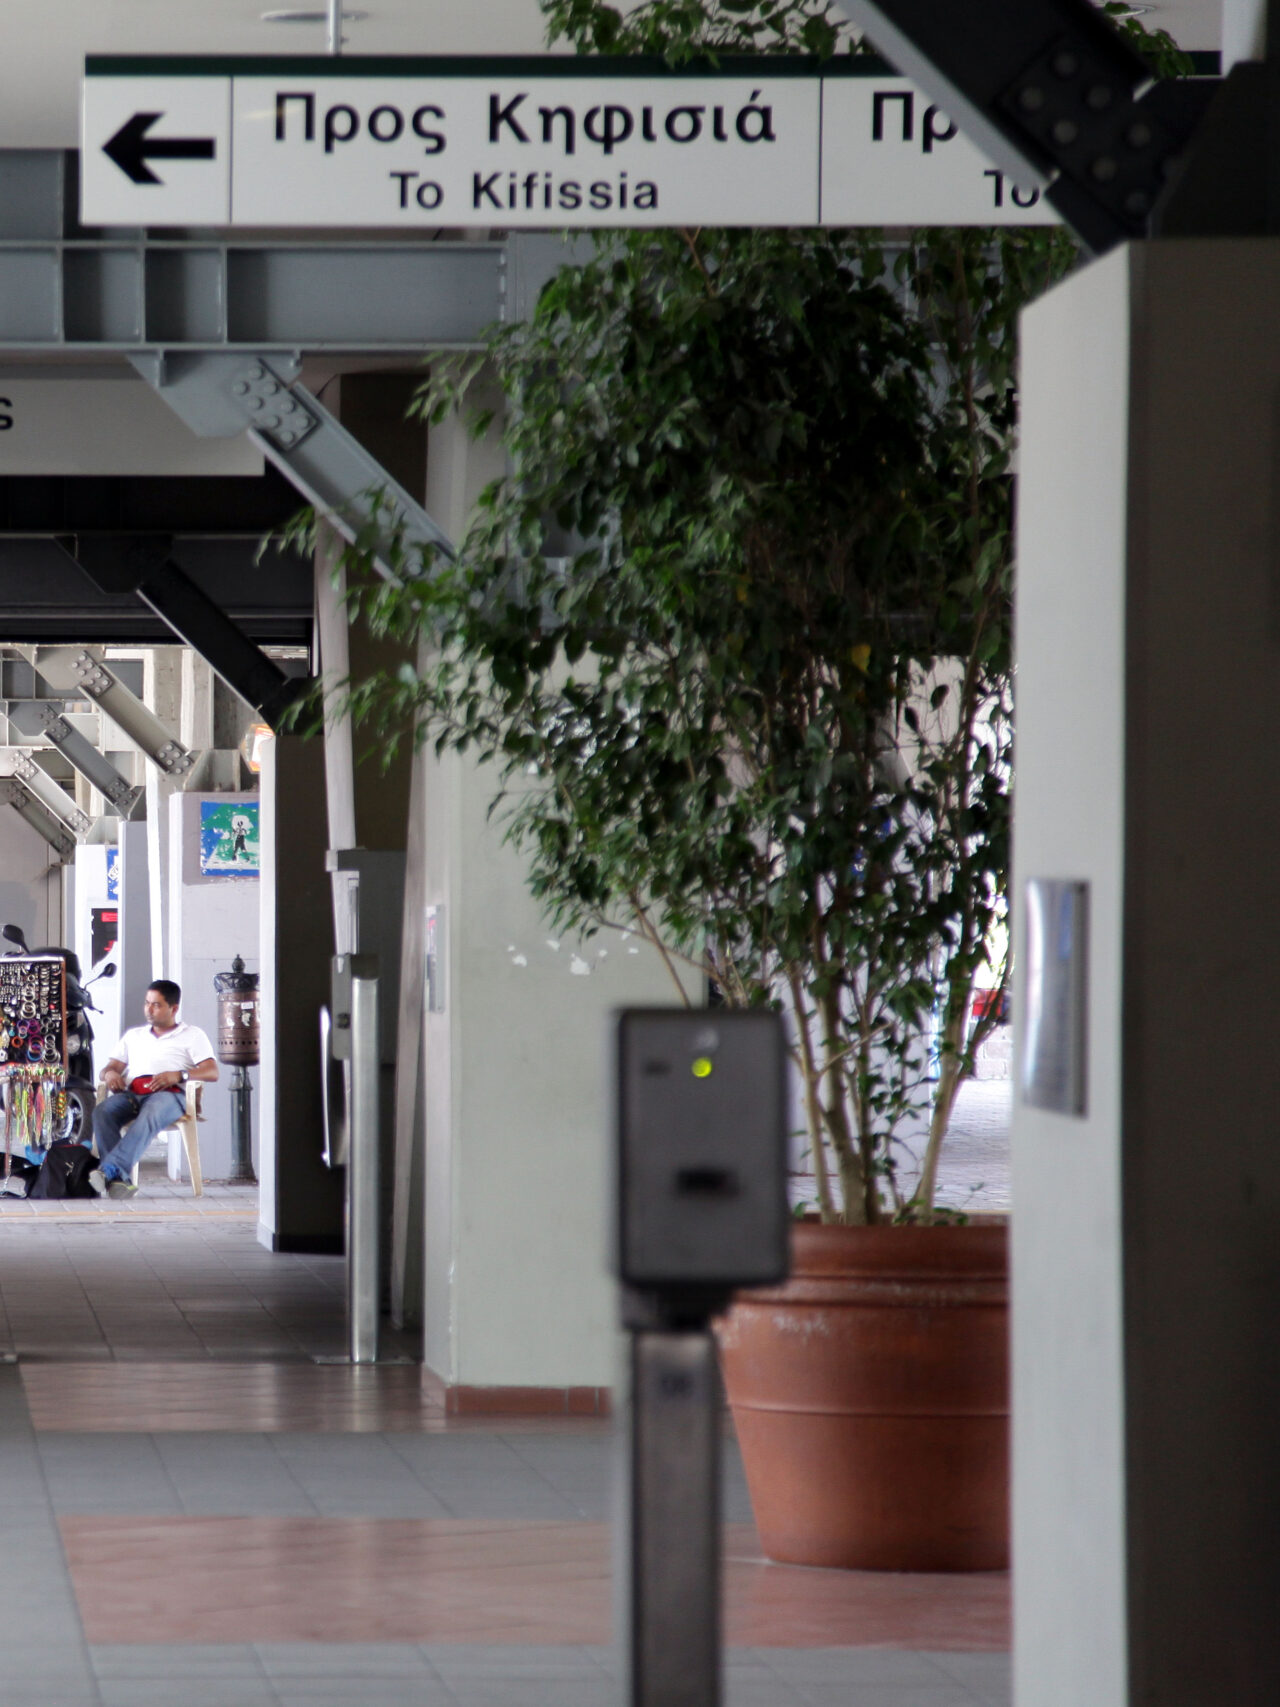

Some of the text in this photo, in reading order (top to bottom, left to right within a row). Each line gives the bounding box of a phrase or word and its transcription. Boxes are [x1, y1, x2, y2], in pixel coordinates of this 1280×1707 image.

[274, 89, 776, 156] Προς Κηφισιά
[871, 90, 959, 154] Πρ
[389, 171, 658, 210] To Kifissia
